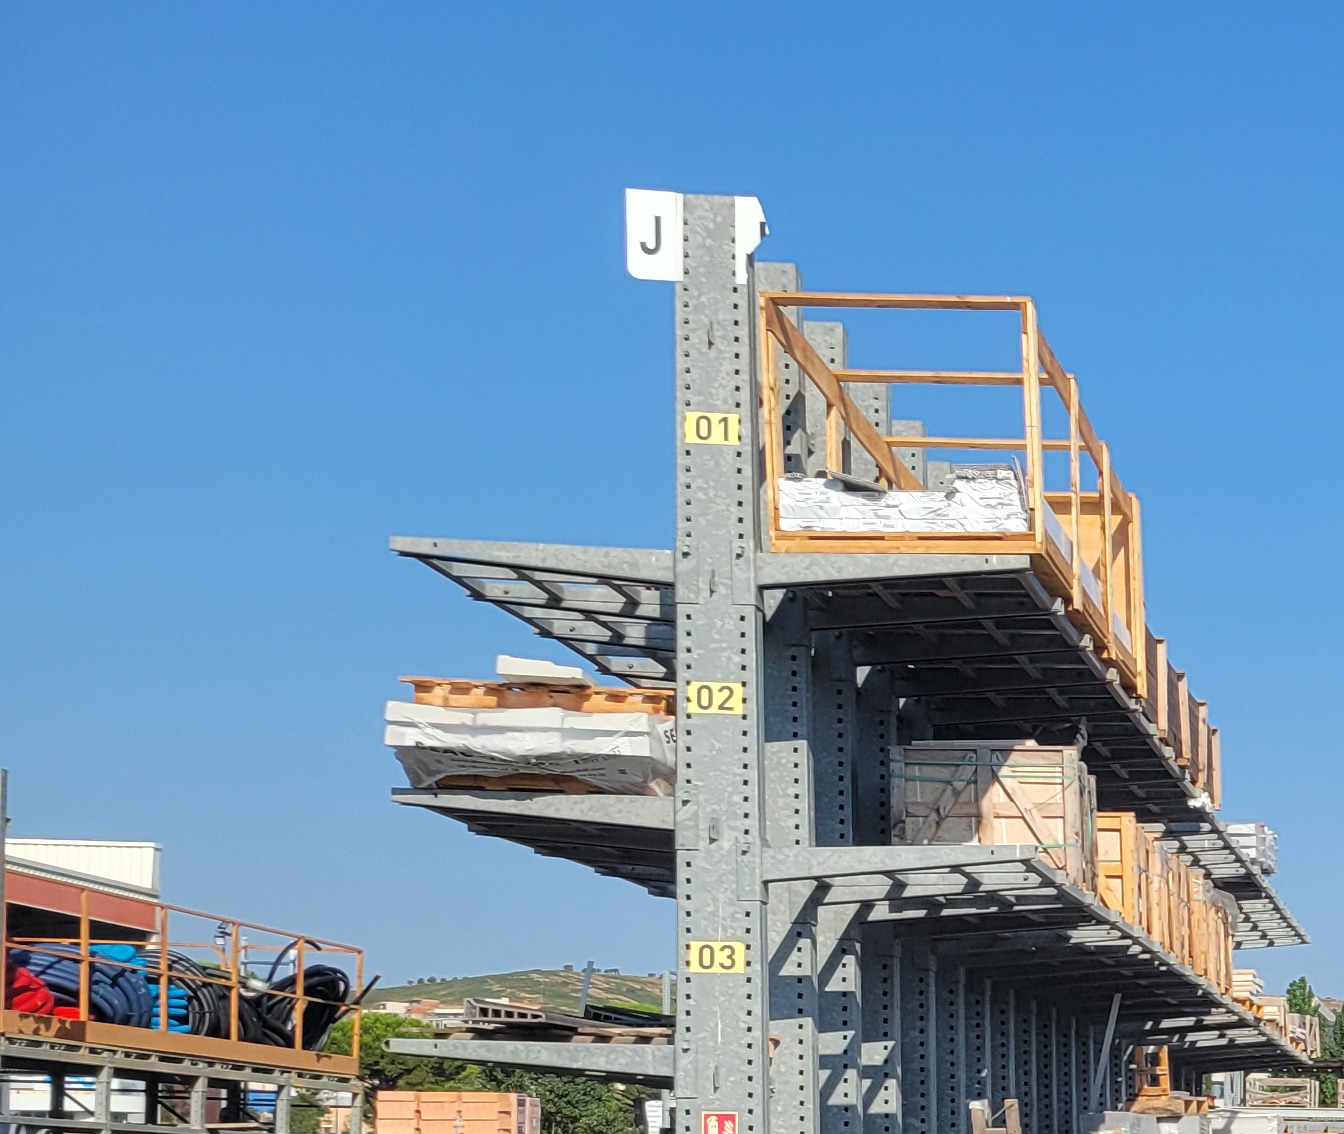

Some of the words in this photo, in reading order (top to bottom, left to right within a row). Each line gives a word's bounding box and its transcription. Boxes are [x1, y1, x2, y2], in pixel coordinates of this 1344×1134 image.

[639, 215, 662, 256] J
[696, 415, 729, 442] 01
[697, 685, 735, 711] 02
[698, 944, 736, 970] 03
